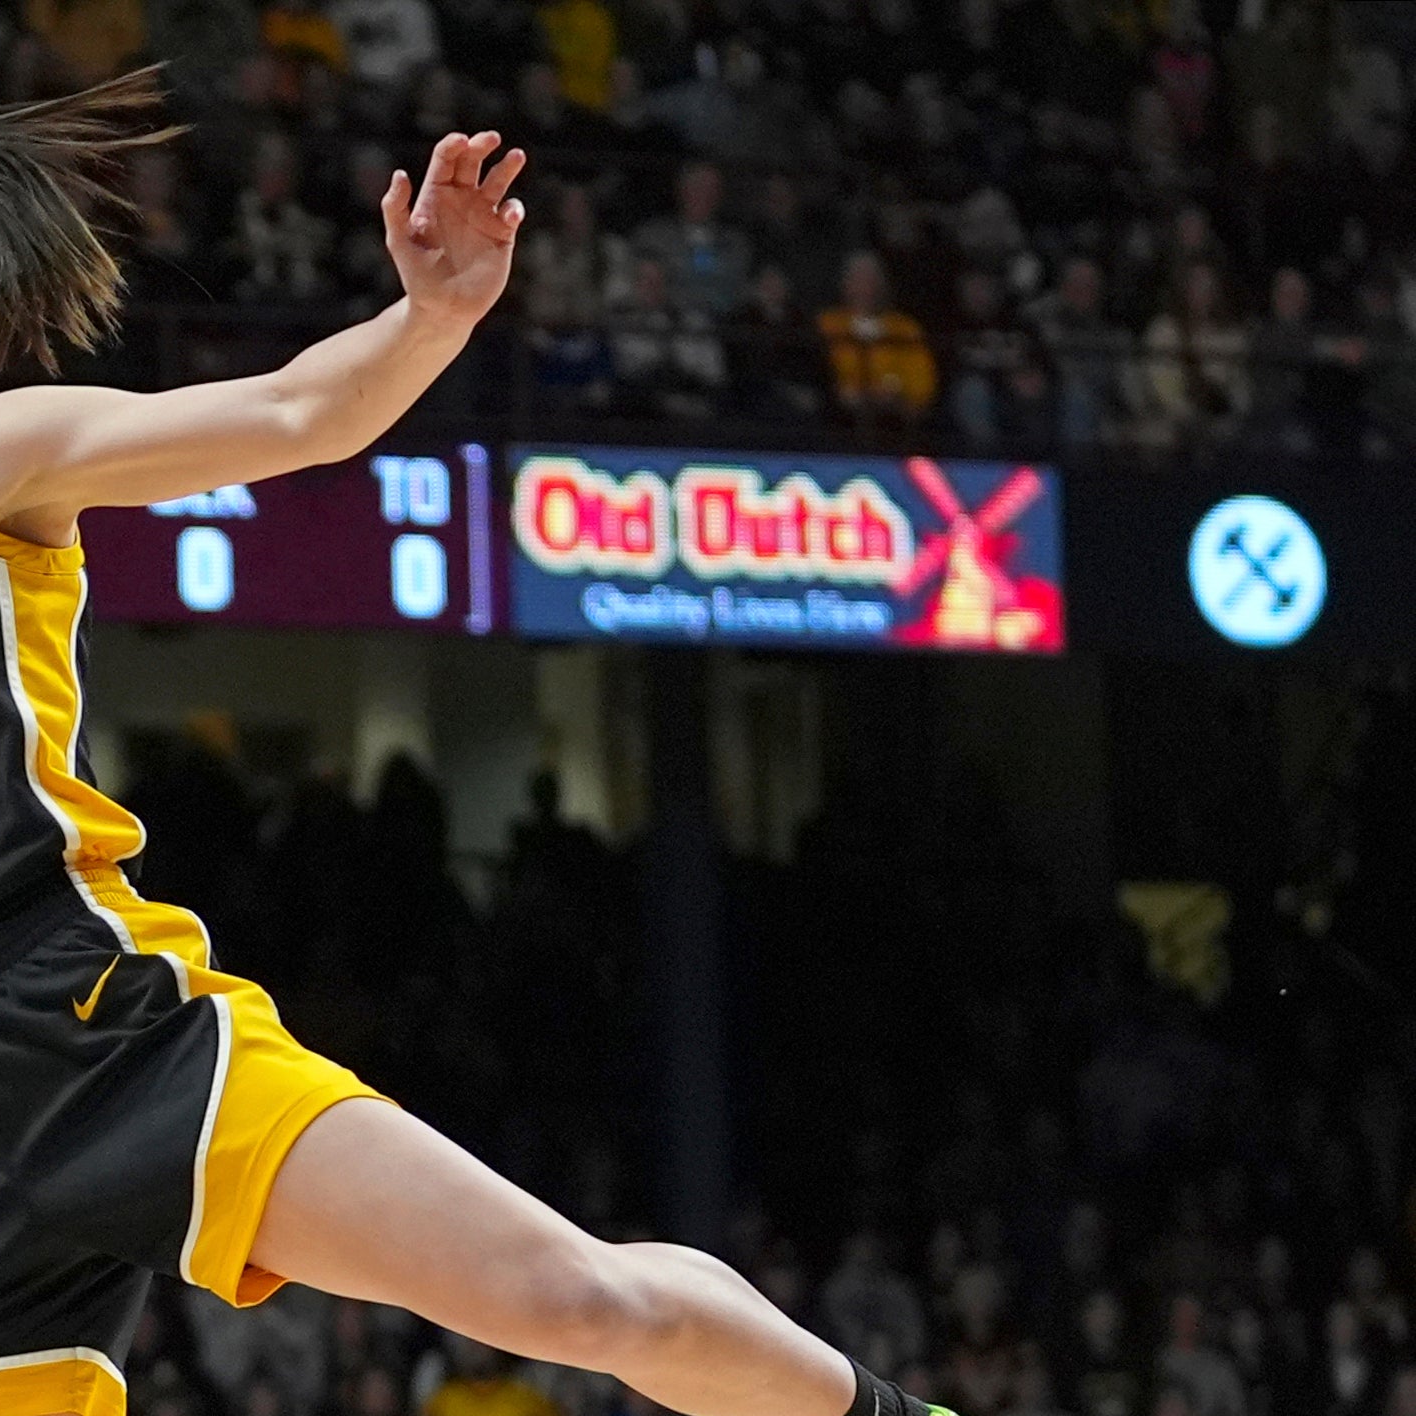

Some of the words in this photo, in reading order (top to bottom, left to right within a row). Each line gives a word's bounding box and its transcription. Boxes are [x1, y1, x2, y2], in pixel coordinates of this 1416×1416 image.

[371, 455, 453, 527] TO
[519, 462, 669, 575] Old
[677, 470, 907, 582] Dutch
[175, 525, 236, 614] 0
[389, 532, 450, 620] 0
